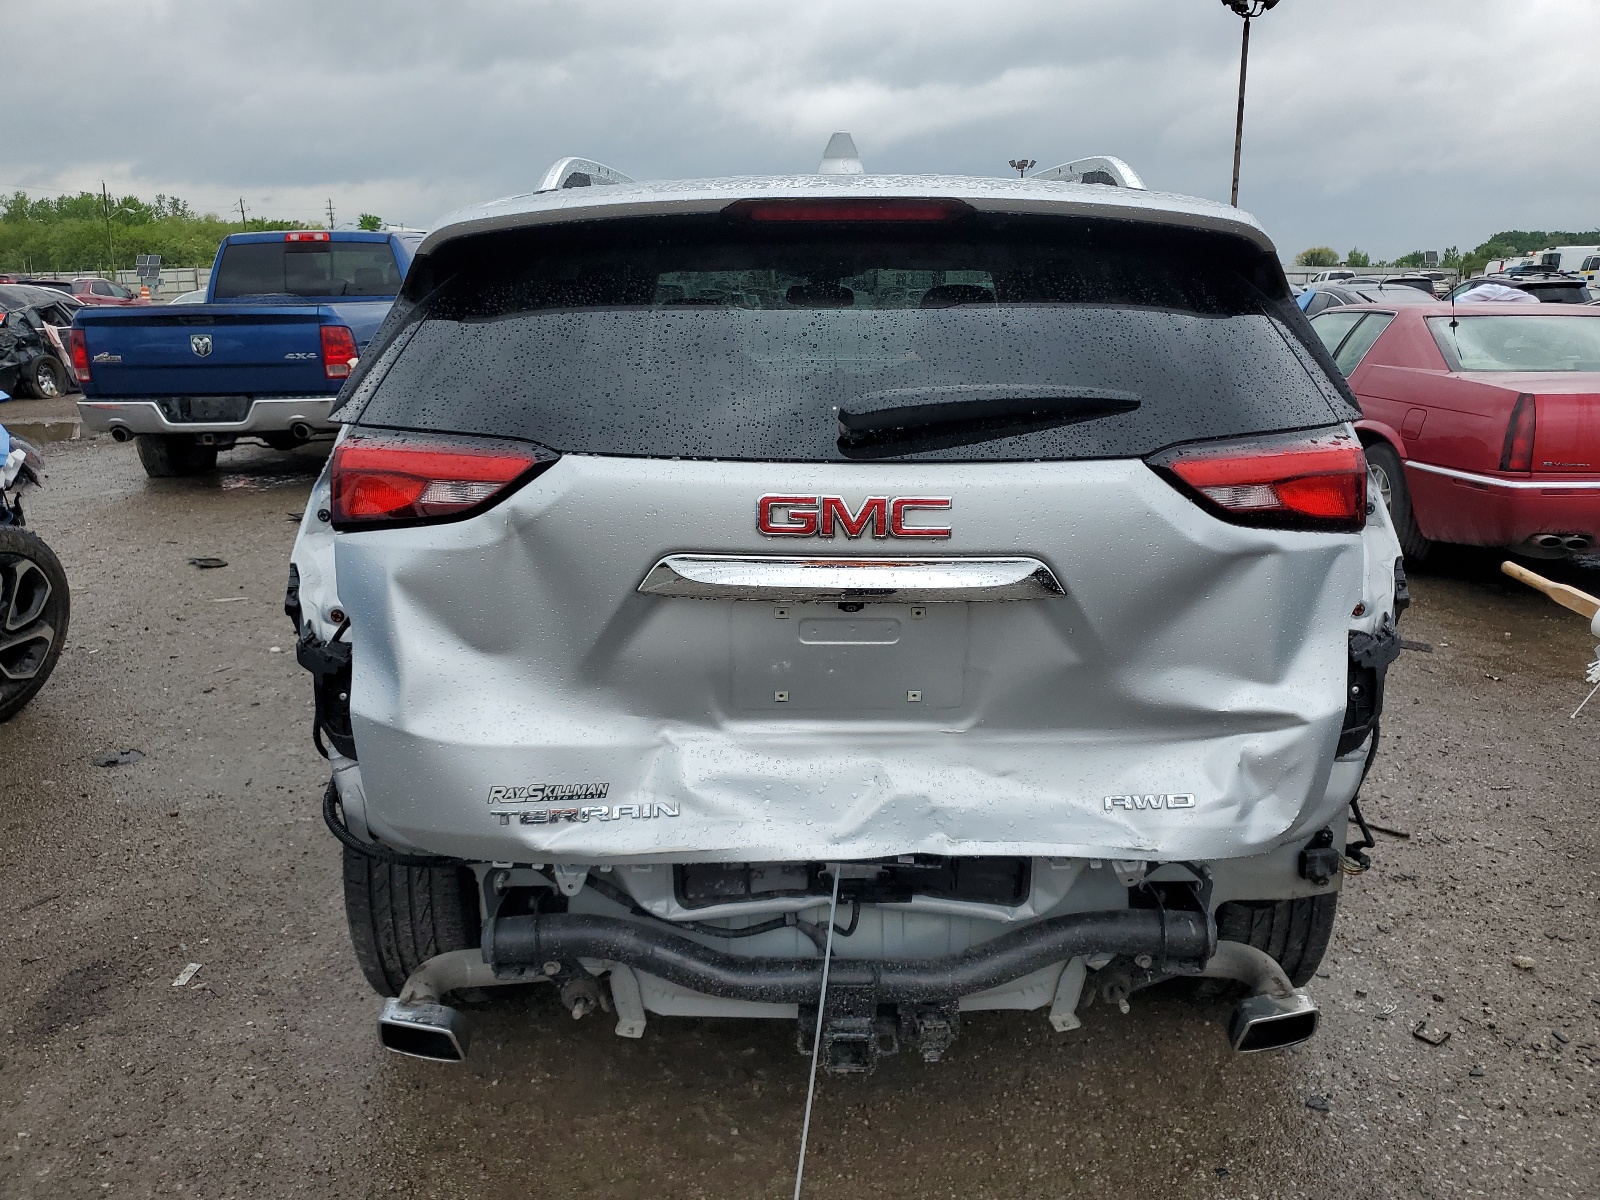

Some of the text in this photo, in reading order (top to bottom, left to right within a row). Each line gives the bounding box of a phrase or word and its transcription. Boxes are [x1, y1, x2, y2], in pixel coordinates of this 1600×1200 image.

[756, 493, 953, 540] GMC
[1104, 793, 1195, 810] AWD
[490, 802, 681, 826] TERRAIN
